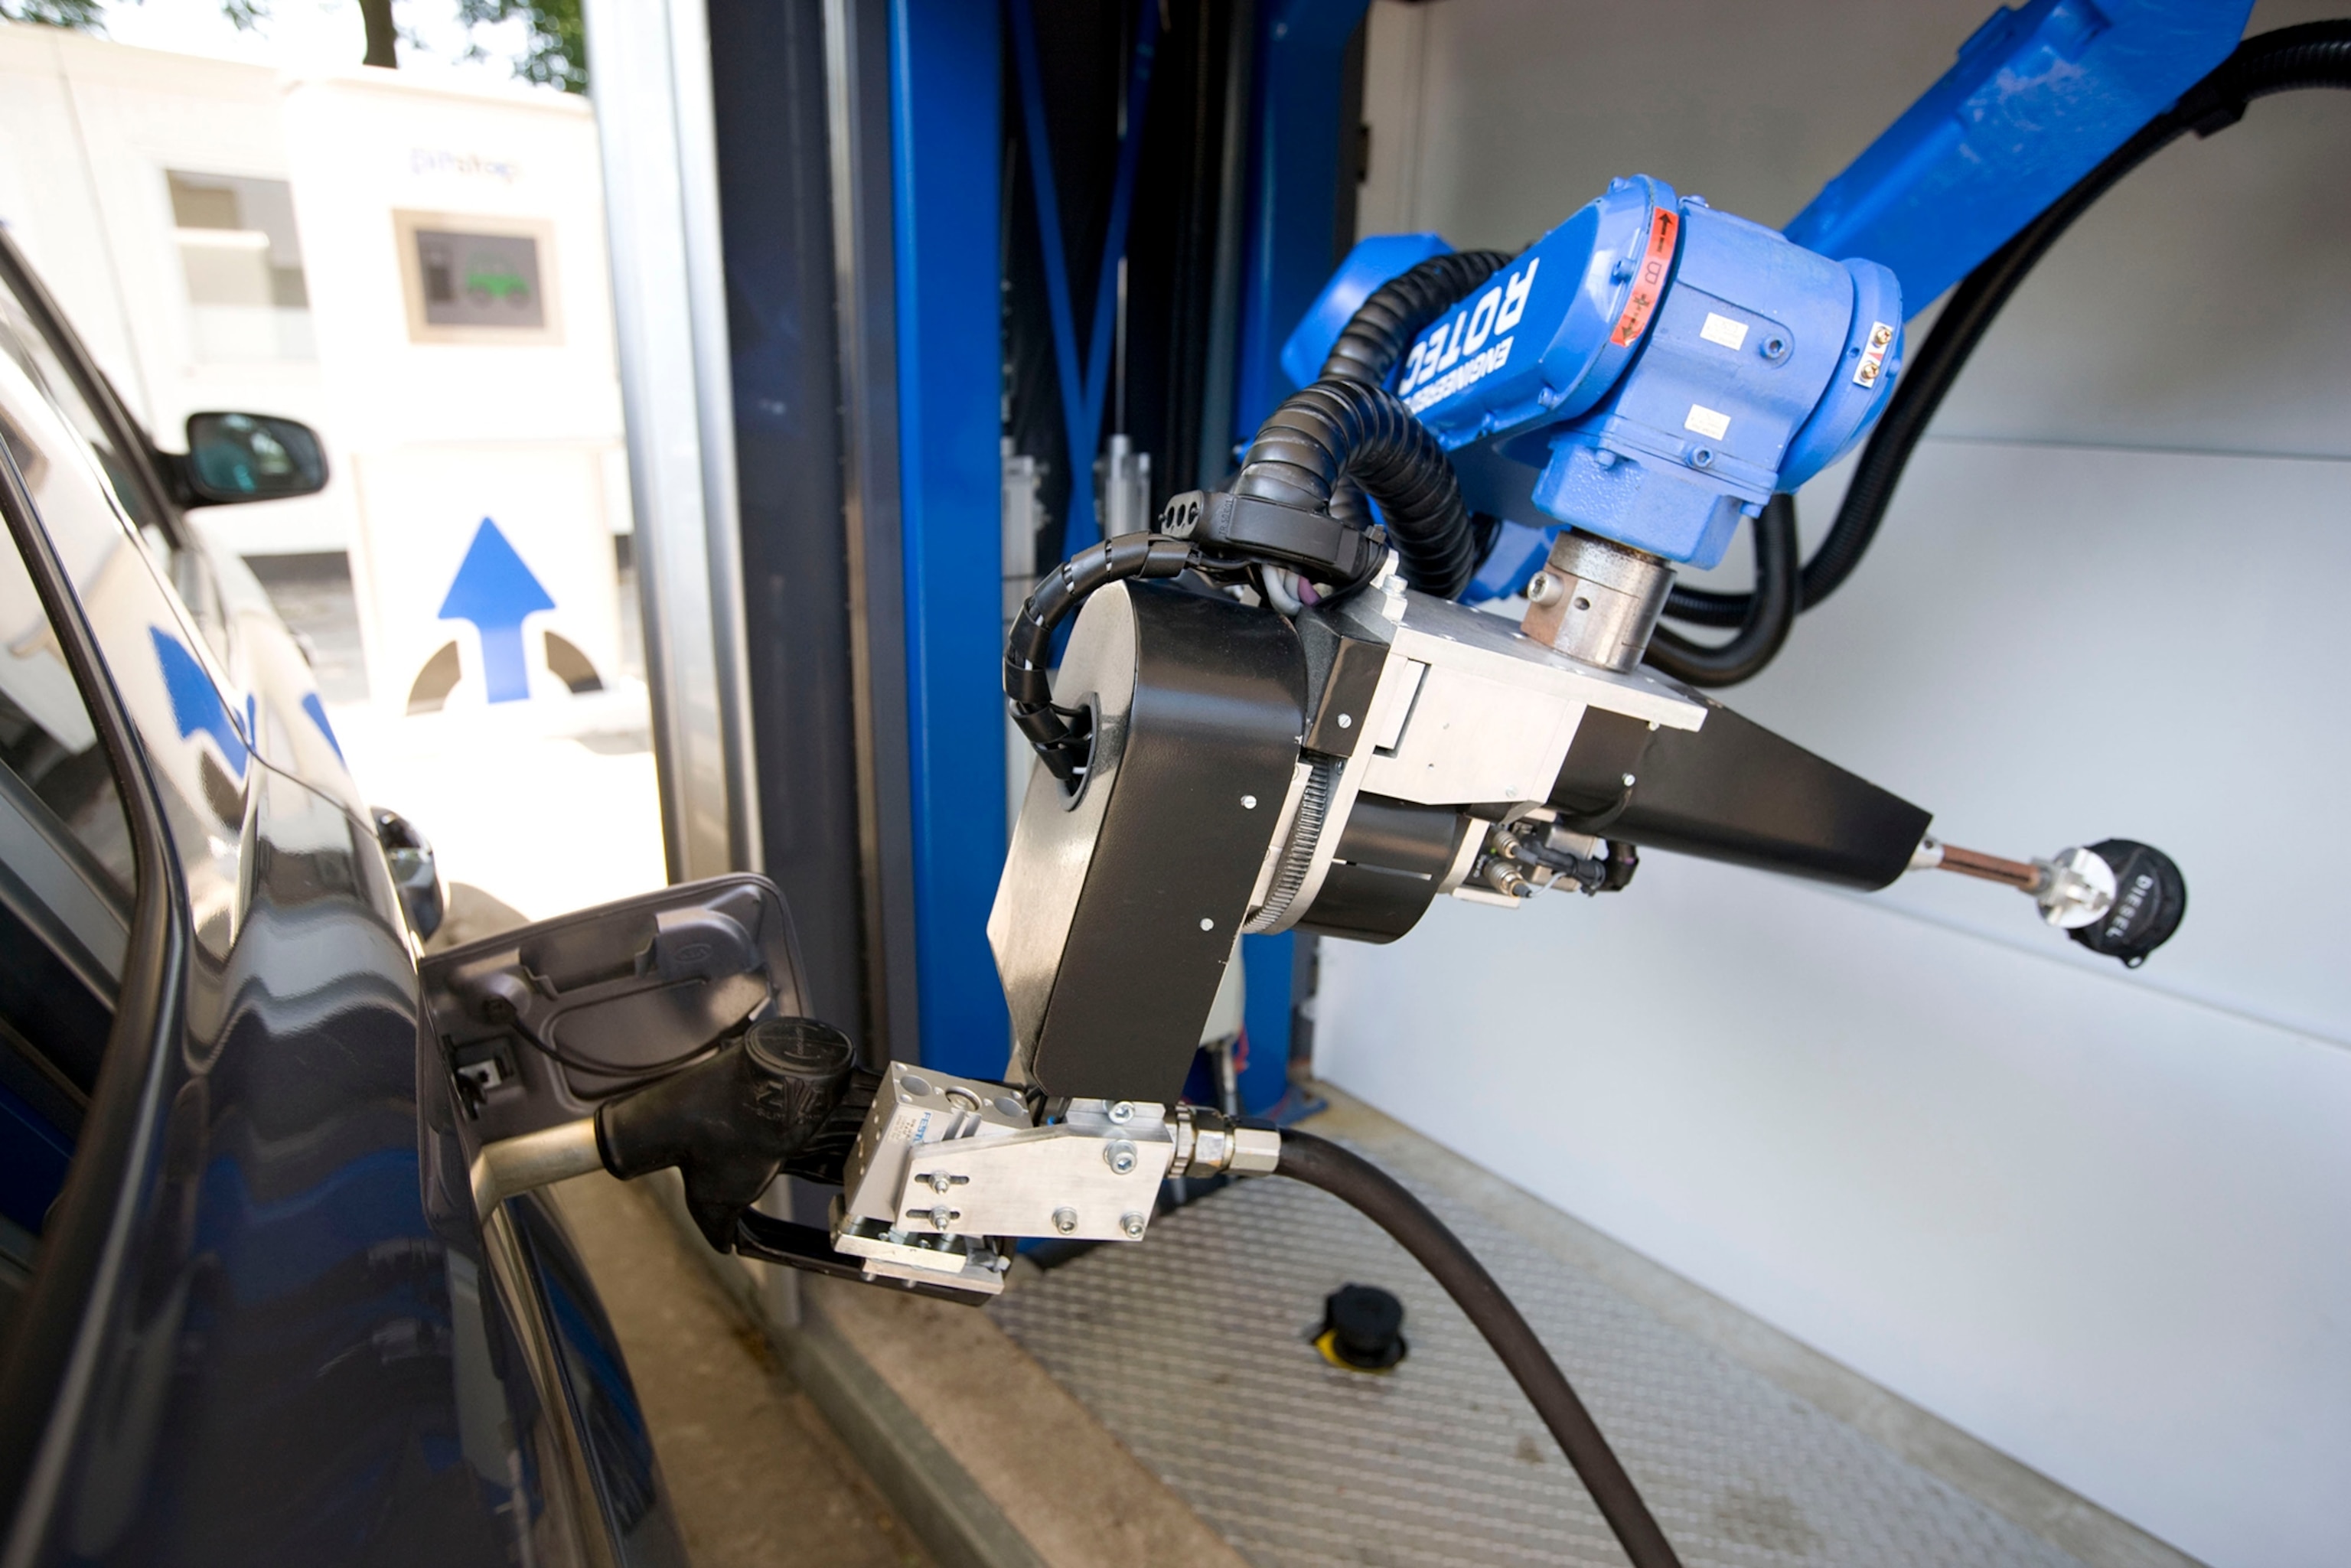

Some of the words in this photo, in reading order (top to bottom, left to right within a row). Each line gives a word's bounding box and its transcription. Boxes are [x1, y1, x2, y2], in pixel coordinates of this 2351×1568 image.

[1645, 261, 1662, 285] B
[1397, 256, 1540, 396] ROTEC
[2105, 874, 2154, 938] DIESEL
